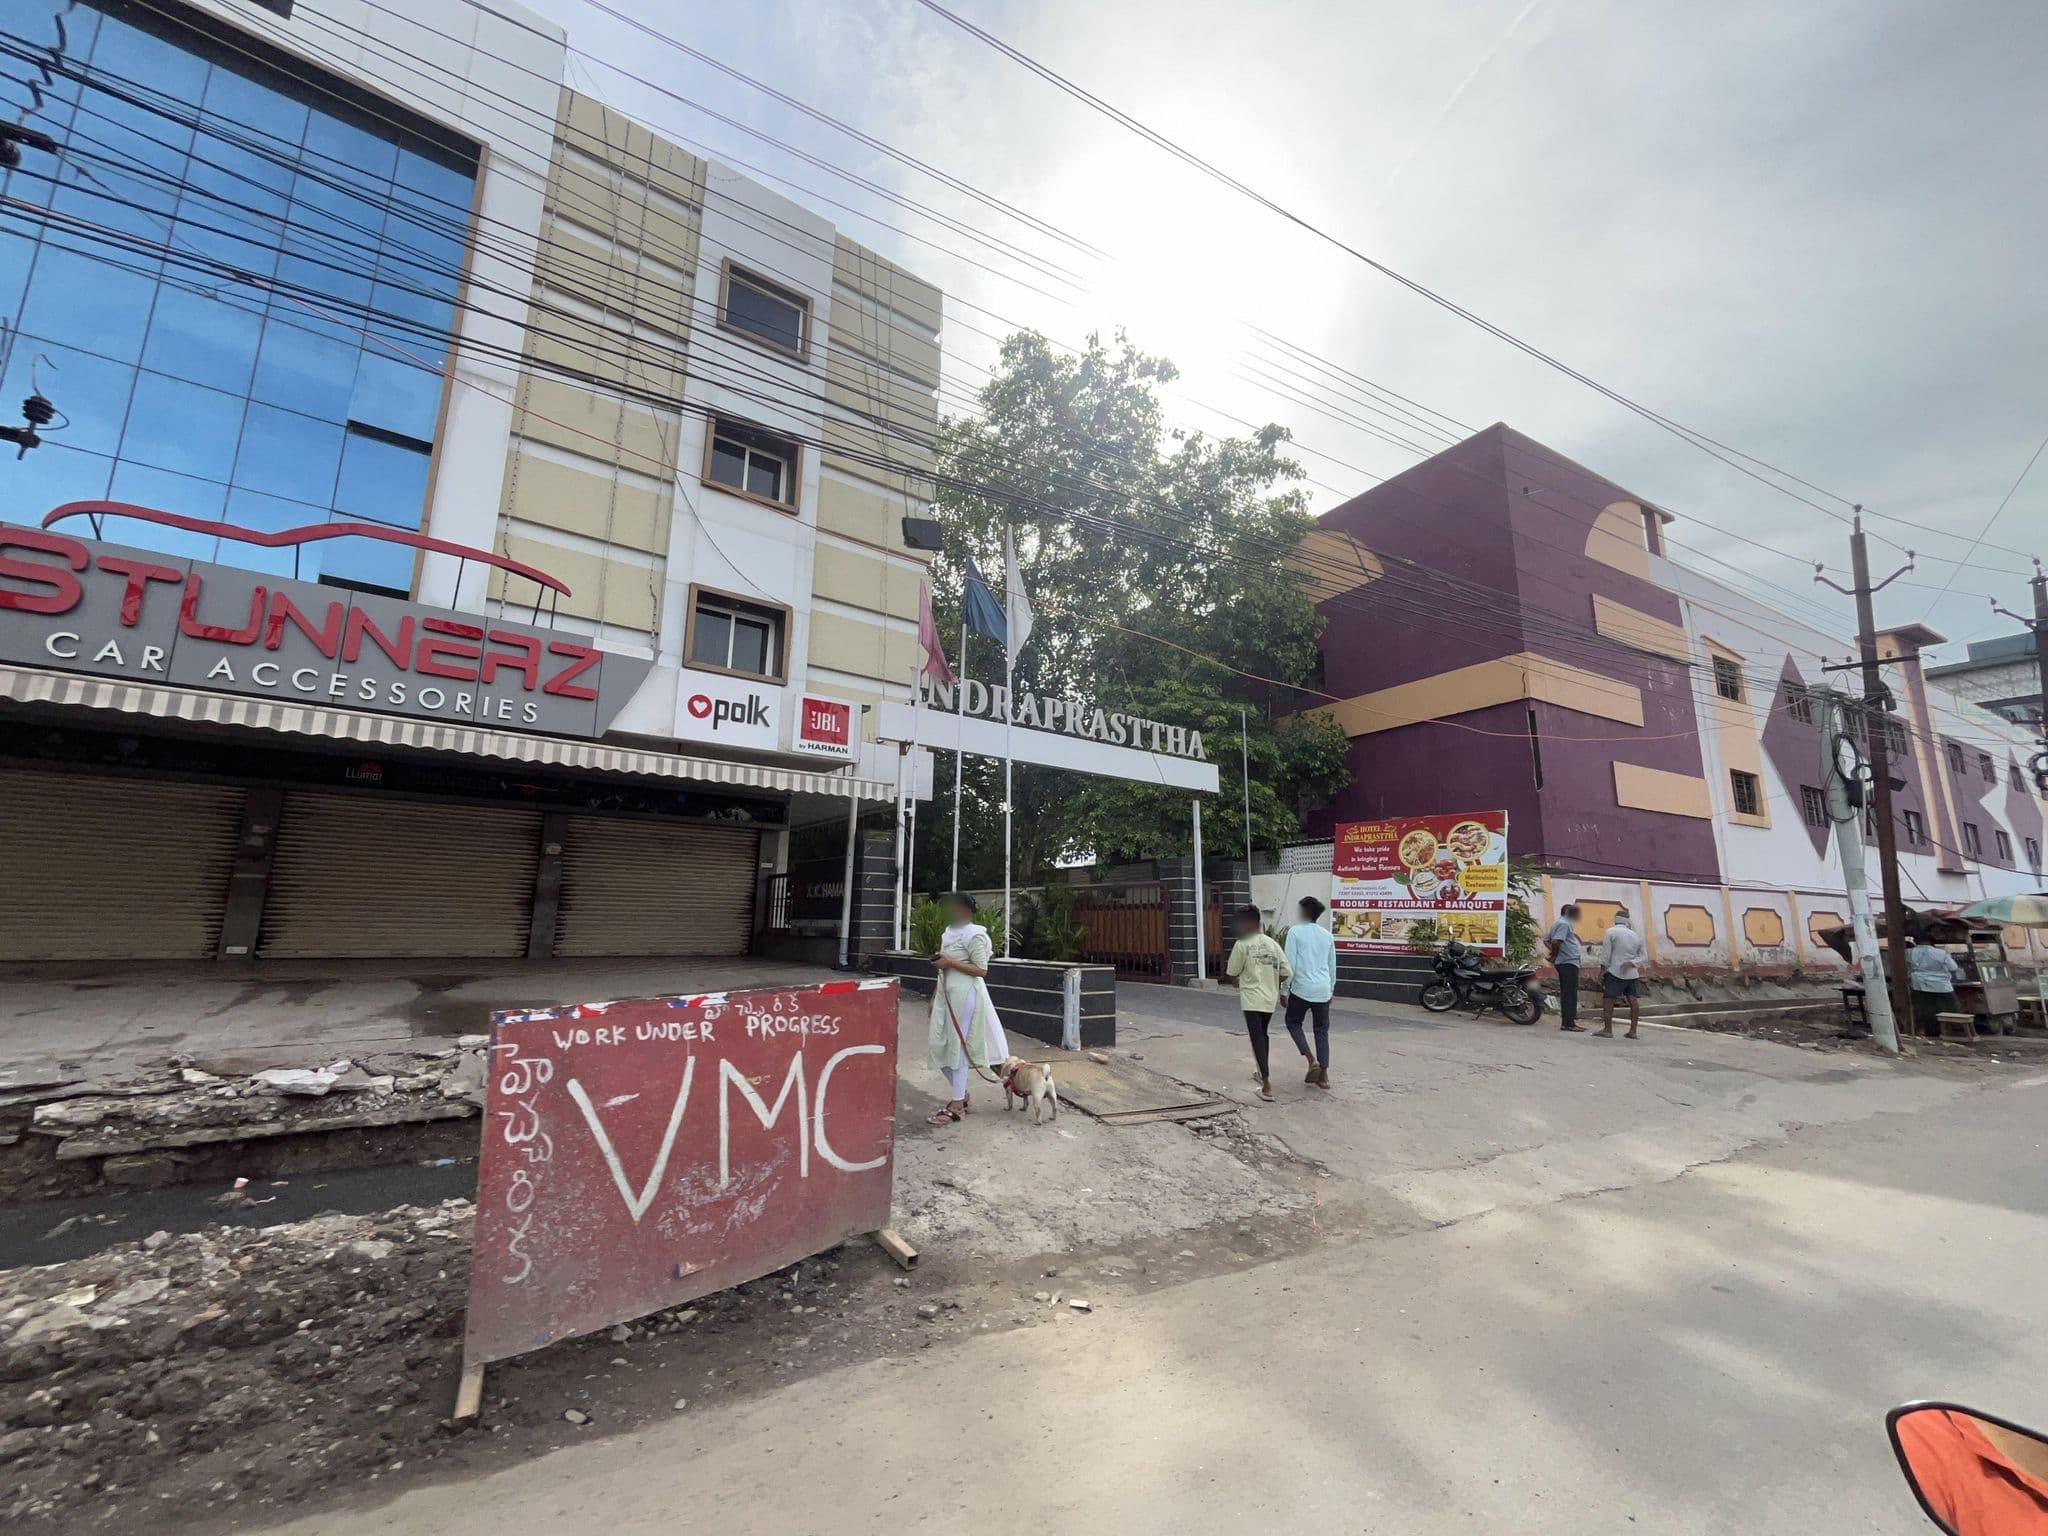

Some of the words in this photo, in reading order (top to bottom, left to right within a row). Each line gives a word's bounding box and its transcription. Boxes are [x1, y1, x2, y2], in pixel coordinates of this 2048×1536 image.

[0, 525, 604, 700] STUNNERZ
[46, 632, 165, 672] CAR
[206, 656, 538, 723] ACCESSORIES
[712, 694, 770, 730] polk
[811, 710, 841, 733] JBL
[807, 743, 849, 755] HARMAN
[1360, 825, 1381, 833] HOTEL
[1340, 901, 1370, 909] ROOMS
[1378, 900, 1436, 909] RESTAURANT
[1445, 901, 1494, 911] BANQUET
[552, 1026, 628, 1050] WORK
[636, 1021, 716, 1043] UNDER
[745, 1013, 842, 1039] PROGRESS
[566, 1045, 887, 1222] VMC
